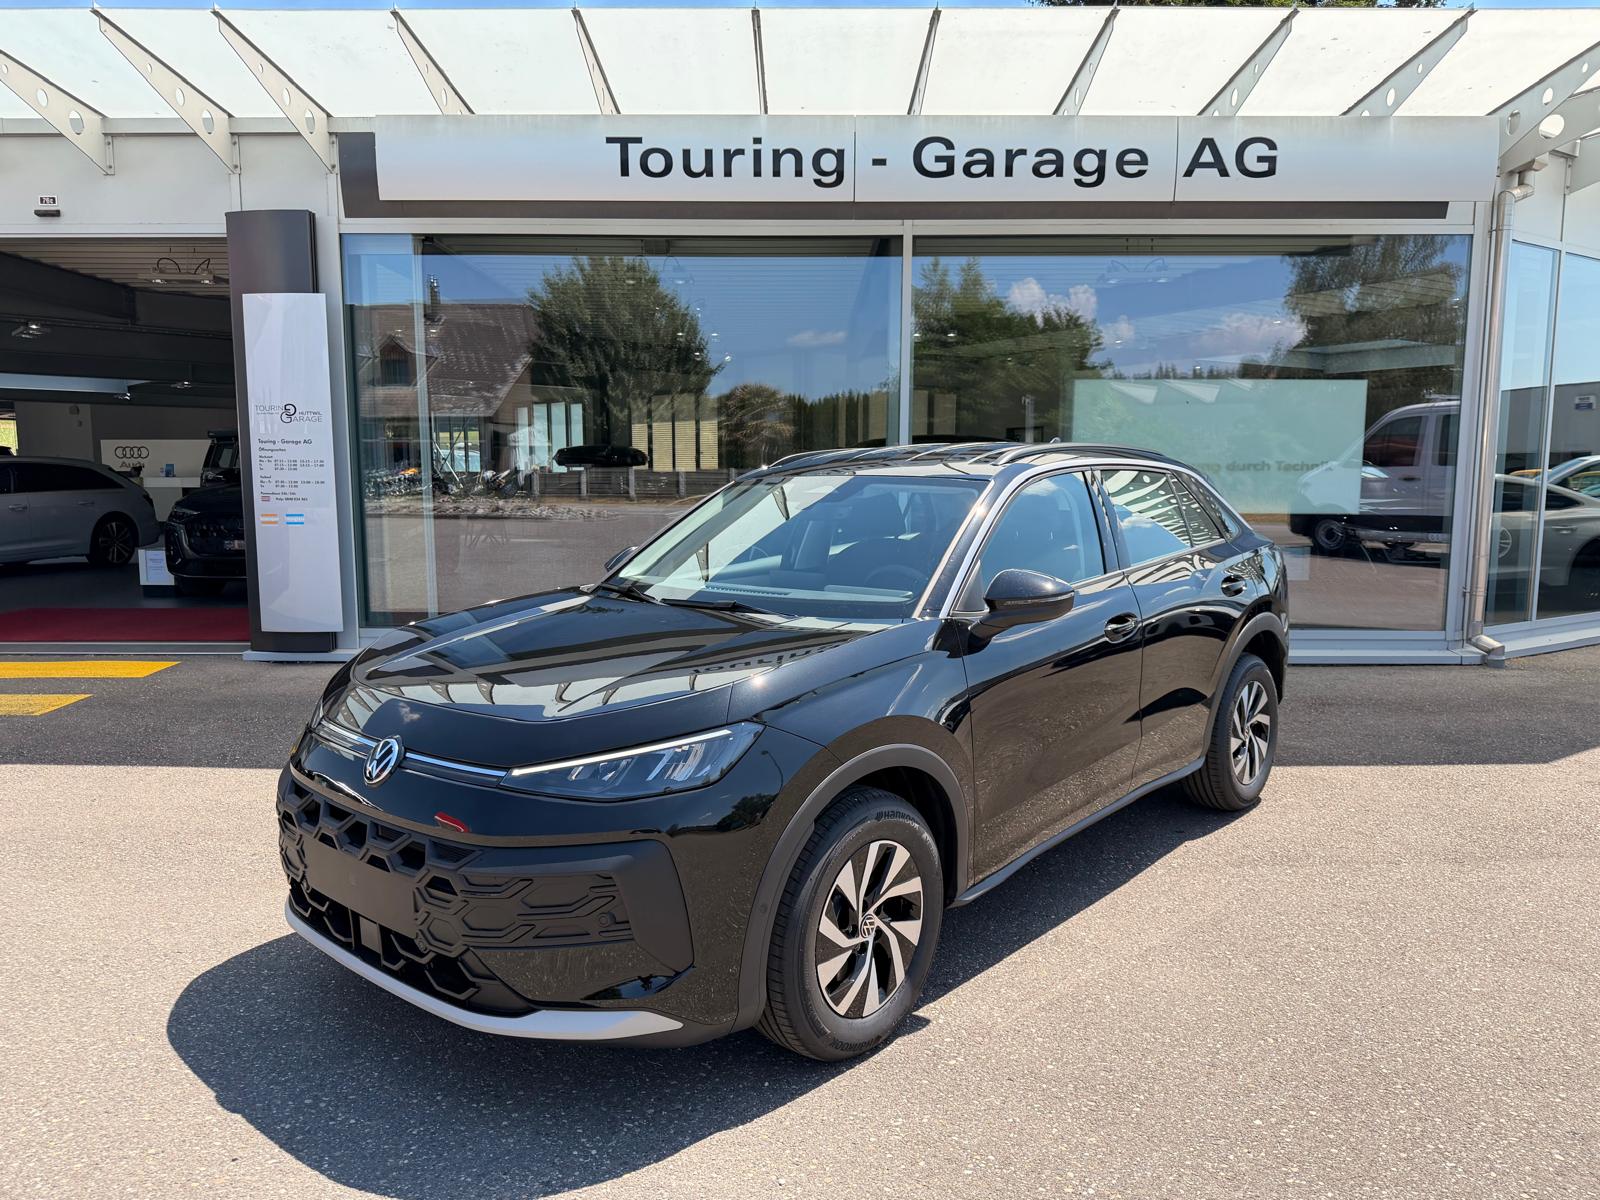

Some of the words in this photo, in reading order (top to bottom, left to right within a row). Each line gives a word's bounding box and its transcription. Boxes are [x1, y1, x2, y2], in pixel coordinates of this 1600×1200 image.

[605, 136, 845, 189] Touring
[871, 158, 887, 167] -
[912, 136, 1149, 189] Garage
[1182, 136, 1278, 179] AG
[1226, 460, 1270, 472] durch
